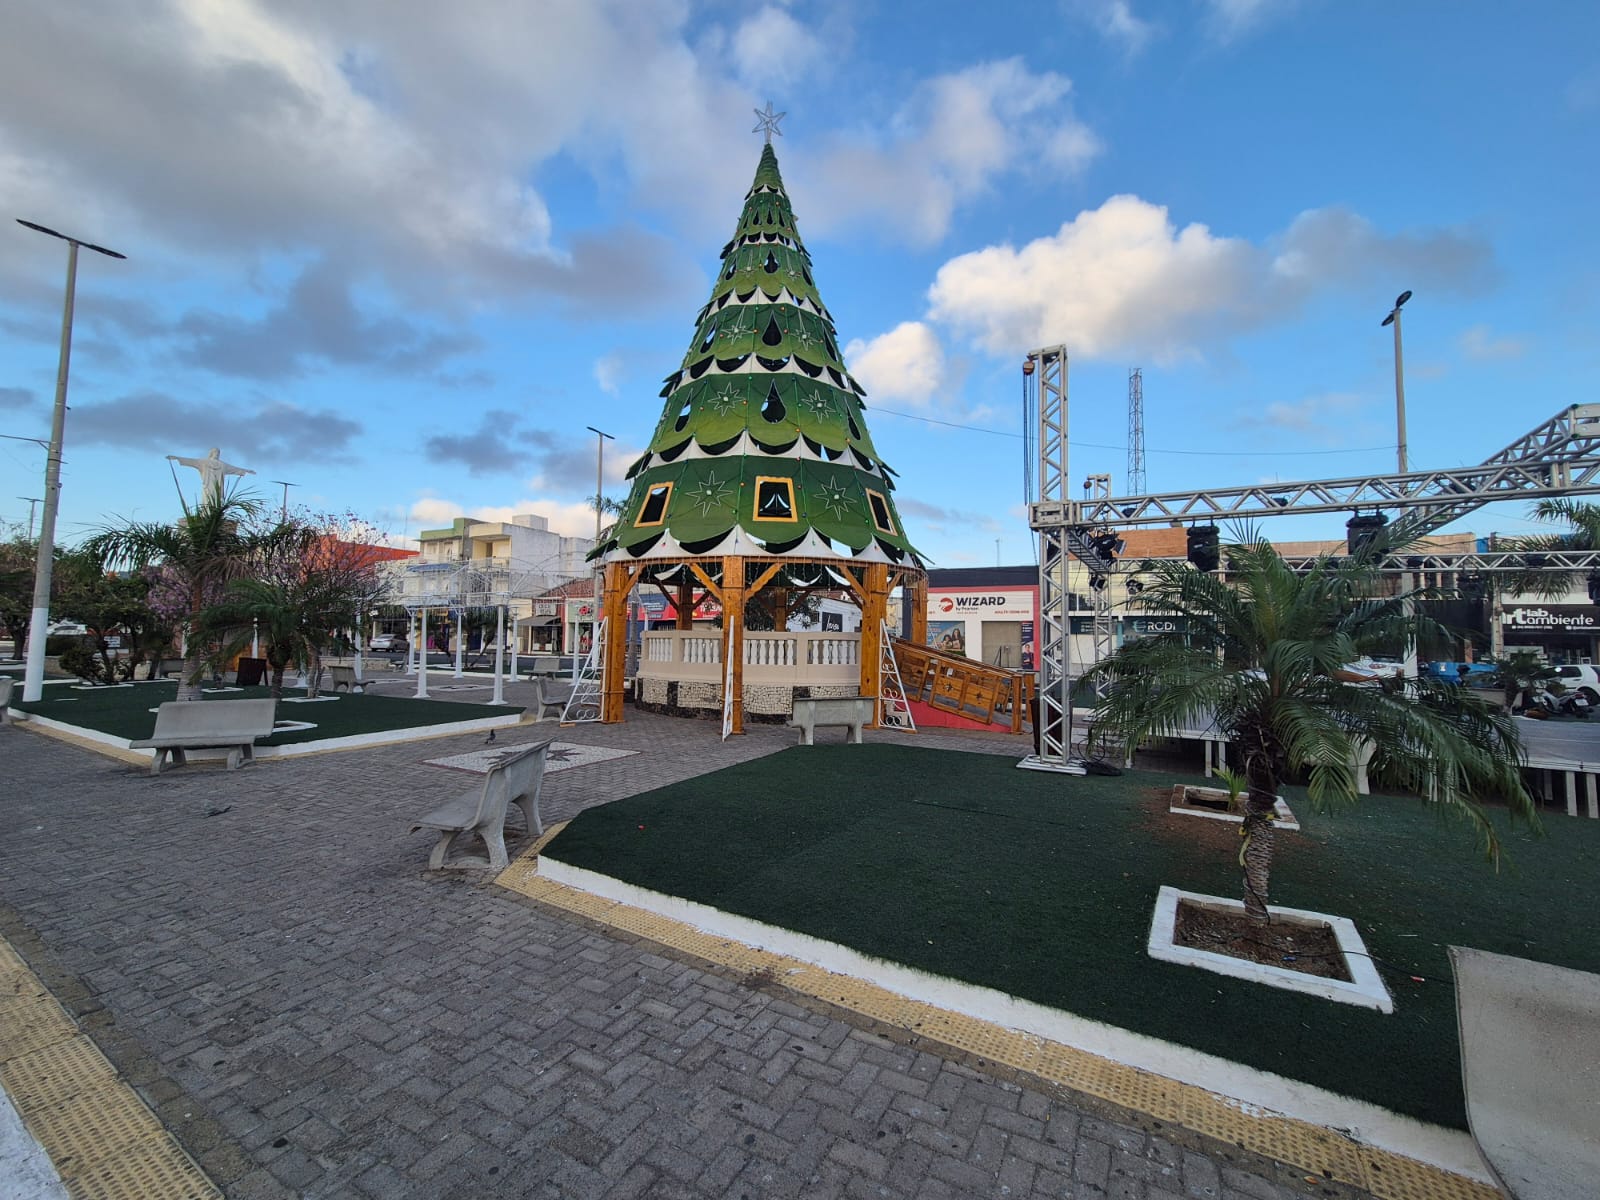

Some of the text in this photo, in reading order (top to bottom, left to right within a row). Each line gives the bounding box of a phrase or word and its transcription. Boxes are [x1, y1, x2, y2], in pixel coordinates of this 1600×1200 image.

[956, 597, 1006, 606] WIZARD
[1526, 608, 1549, 617] lab
[1526, 614, 1594, 625] ambiente
